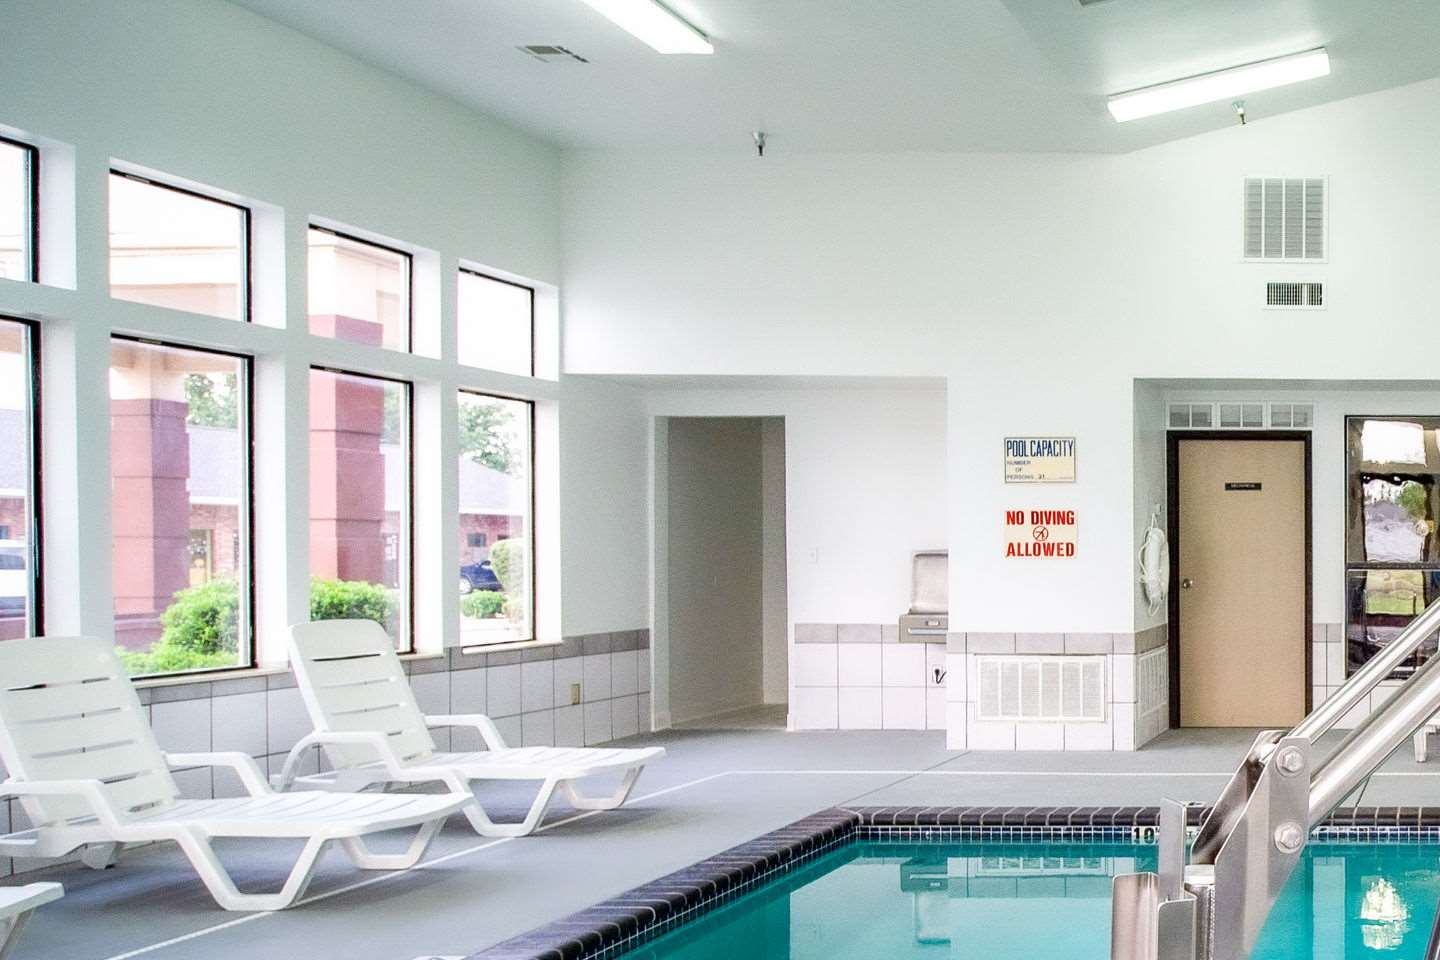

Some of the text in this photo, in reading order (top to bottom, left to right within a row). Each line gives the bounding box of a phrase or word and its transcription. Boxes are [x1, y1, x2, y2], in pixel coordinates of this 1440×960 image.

[1006, 439, 1074, 457] POOL CAPACITY
[1006, 511, 1075, 526] NO DIVING
[1006, 542, 1075, 557] ALLOWED
